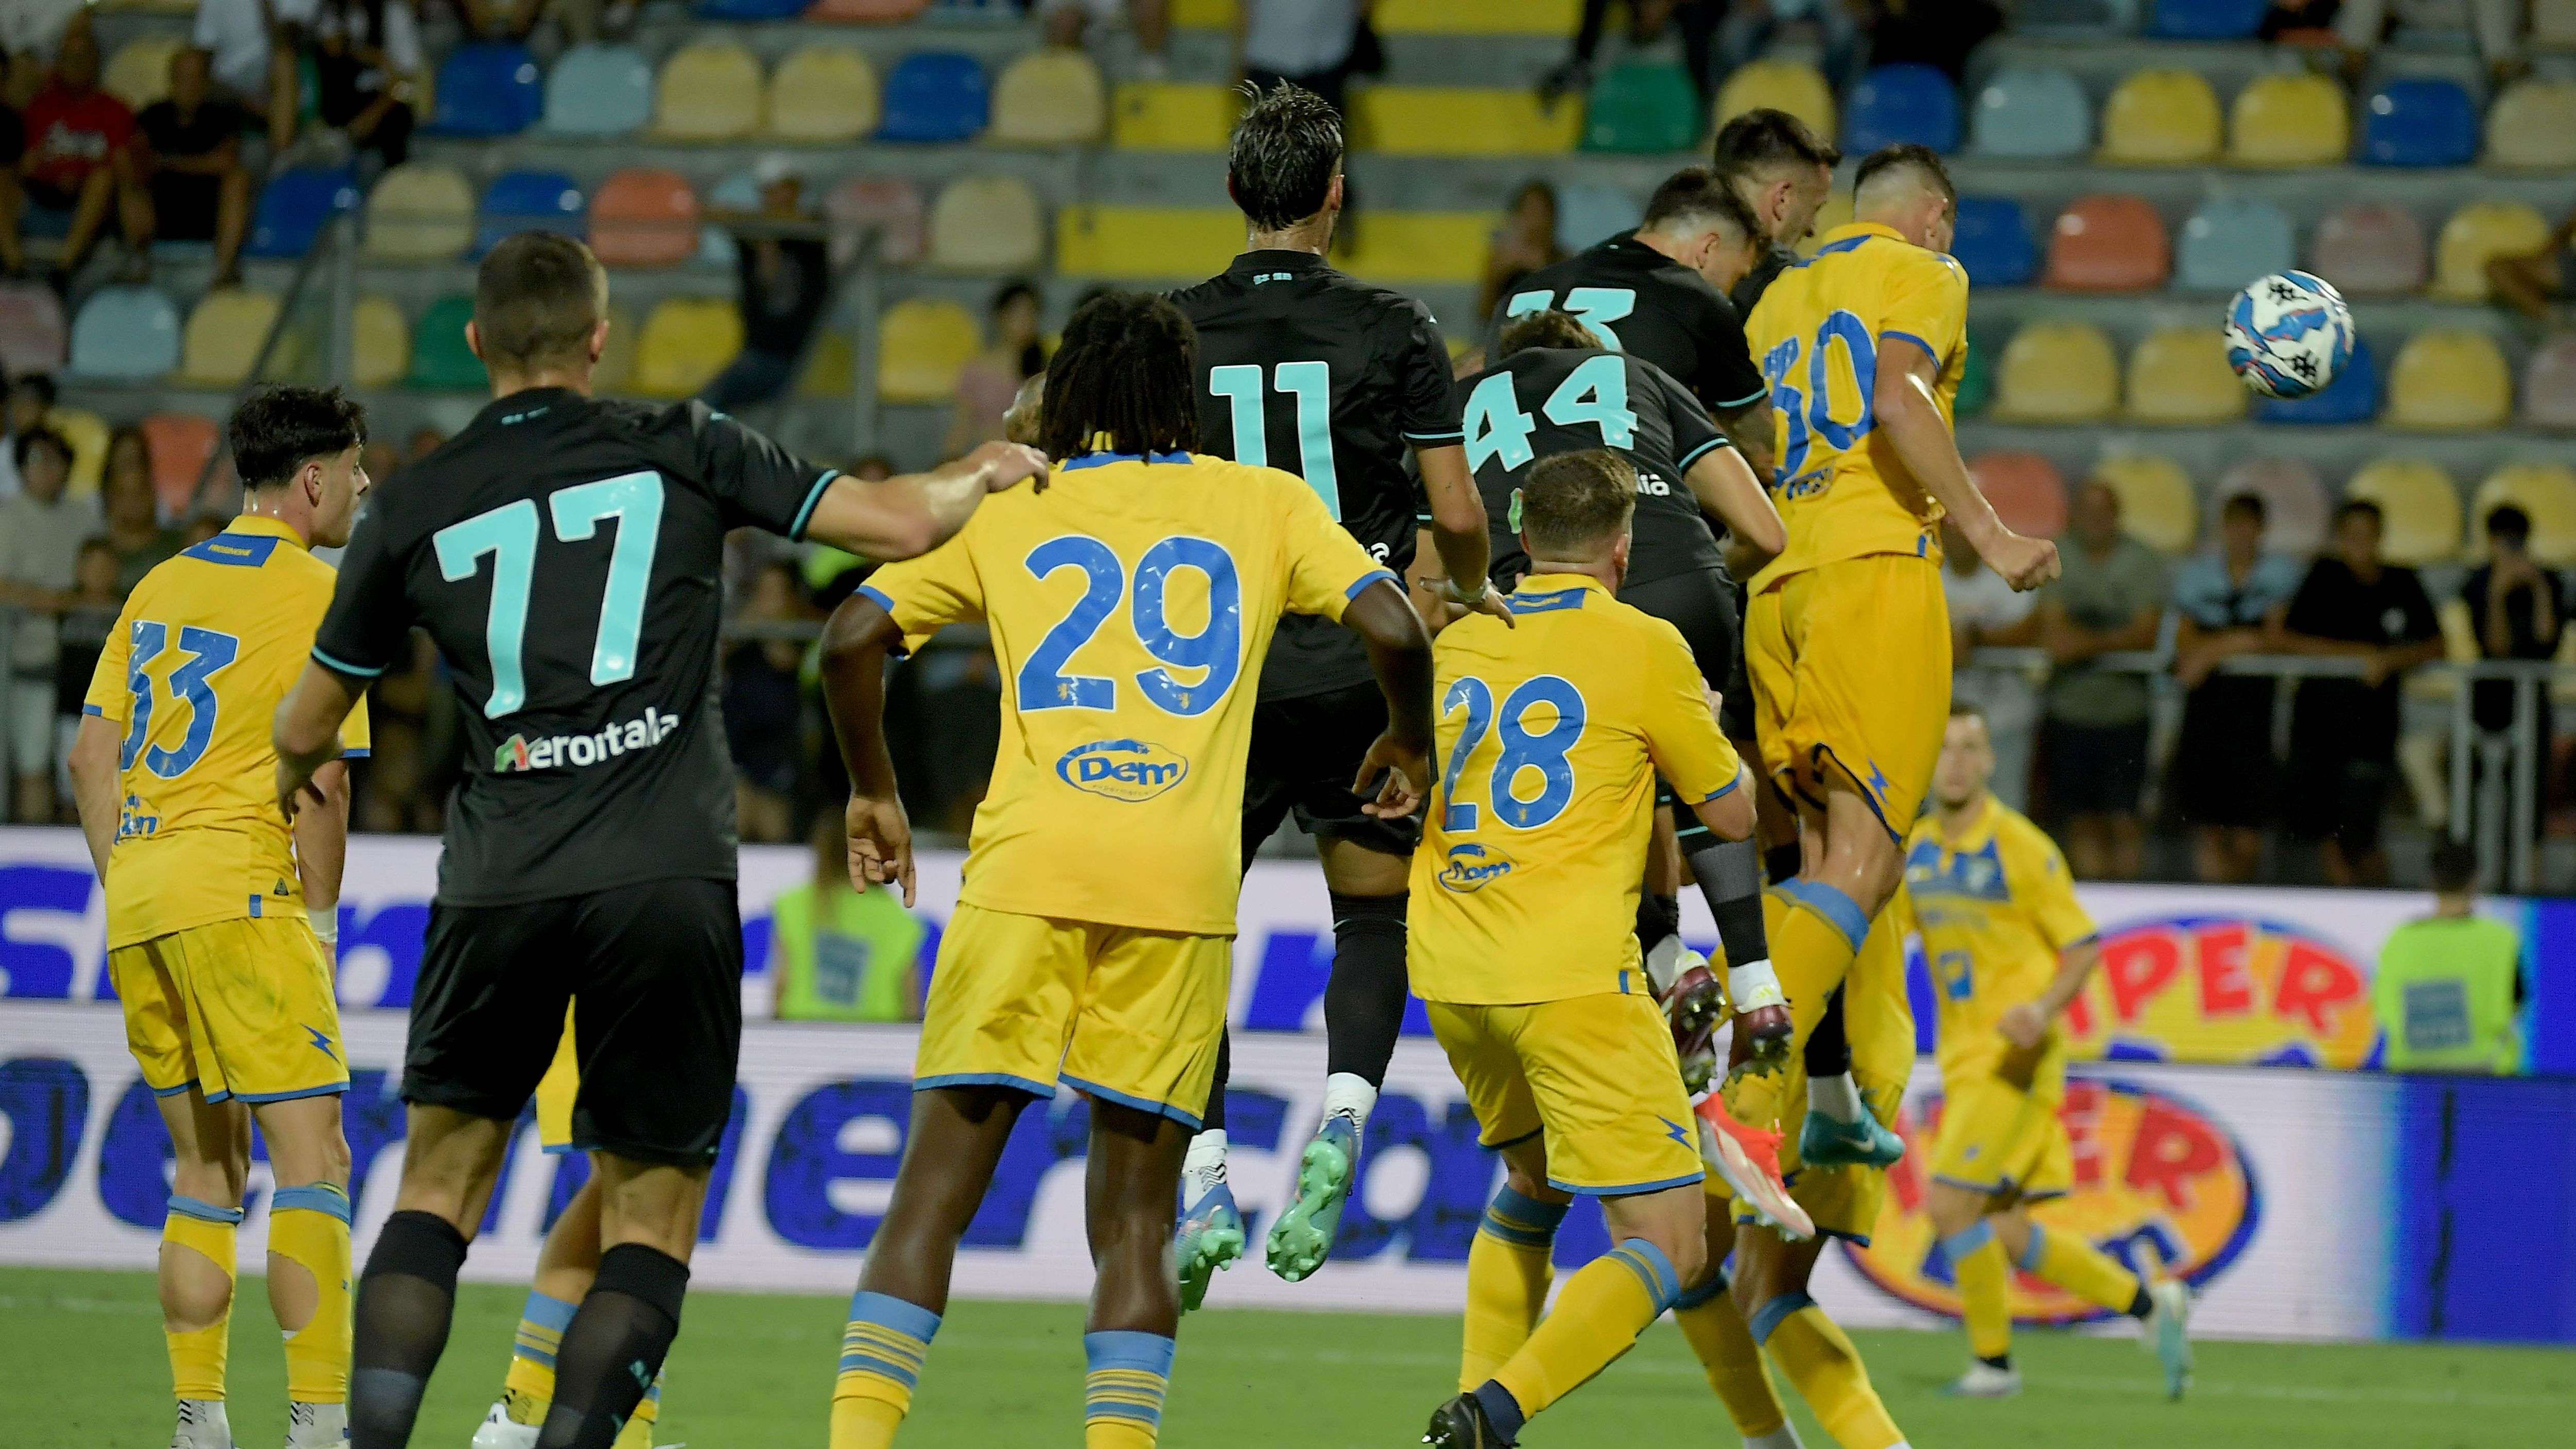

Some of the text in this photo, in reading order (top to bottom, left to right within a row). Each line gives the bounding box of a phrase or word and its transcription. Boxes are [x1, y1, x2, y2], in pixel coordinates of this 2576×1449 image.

[1210, 361, 1342, 522] 11
[1461, 354, 1639, 475] 44
[1763, 309, 1878, 489] 30
[432, 470, 665, 720] 77
[1017, 533, 1242, 717] 29
[119, 619, 240, 779] 33
[1078, 757, 1178, 785] Dem
[1442, 674, 1587, 833] 28
